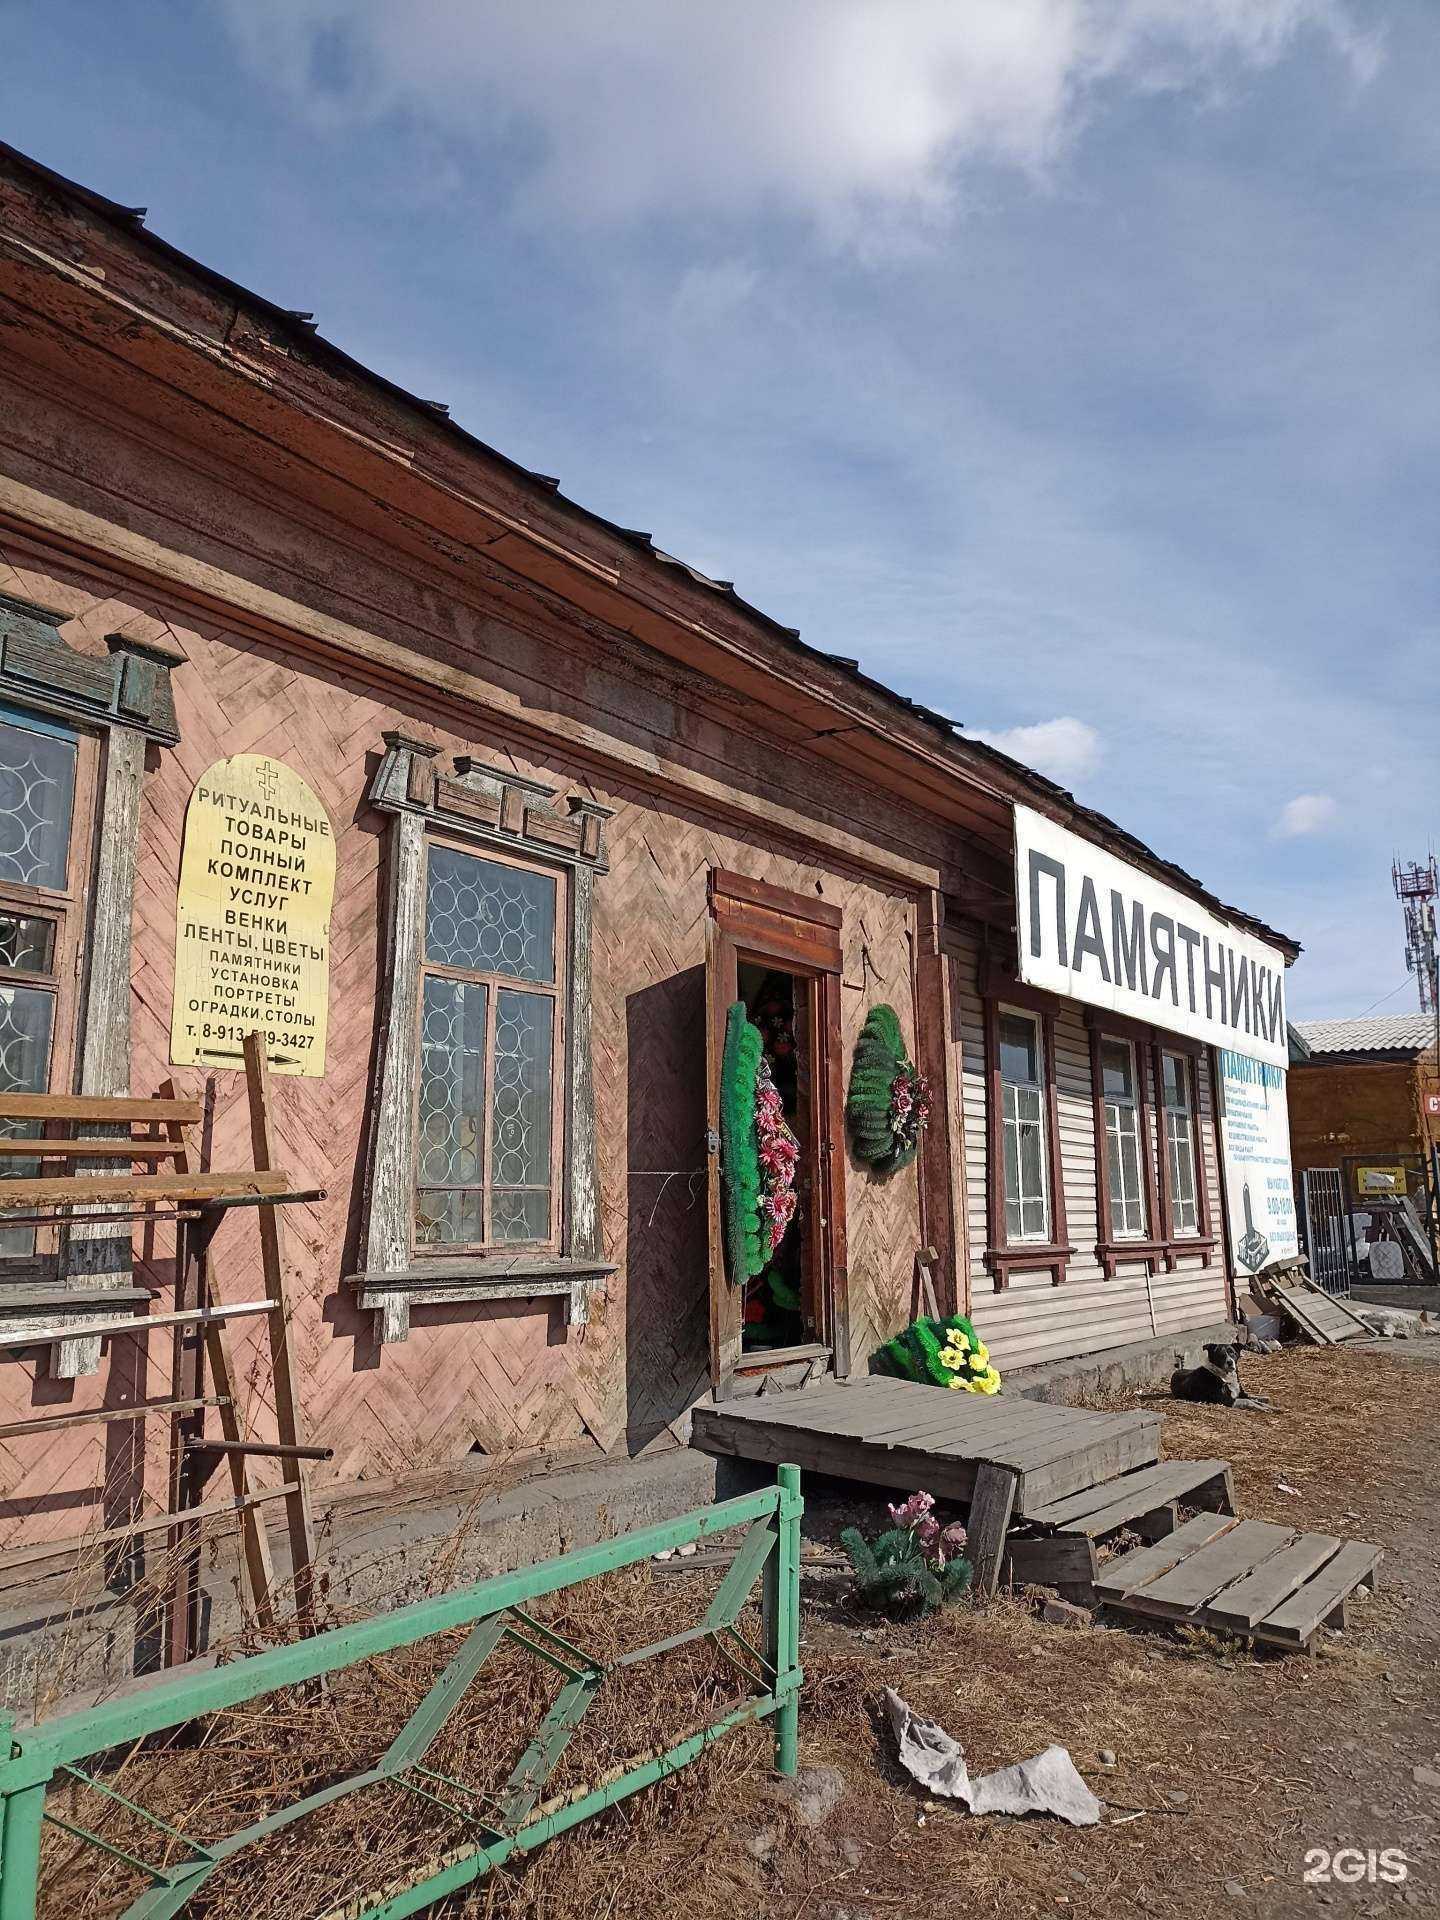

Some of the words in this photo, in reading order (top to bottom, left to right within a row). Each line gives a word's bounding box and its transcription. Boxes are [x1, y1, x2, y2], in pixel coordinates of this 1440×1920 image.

[198, 787, 330, 837] РИТУАЛЬНЫЕ
[225, 816, 306, 850] ТОВАРЫ
[220, 839, 306, 873] ПОЛНЫЙ
[207, 858, 313, 895] КОМПЛЕКТ
[229, 886, 289, 911] УСЛУГ
[225, 909, 288, 935] ВЕНКИ
[209, 950, 301, 975] ПАМЯТНИКИ
[1028, 848, 1285, 1048] ПАМЯТНИКИ
[210, 967, 300, 991] УСТАНОВКА
[213, 985, 296, 1007] ПОРТРЕТЫ
